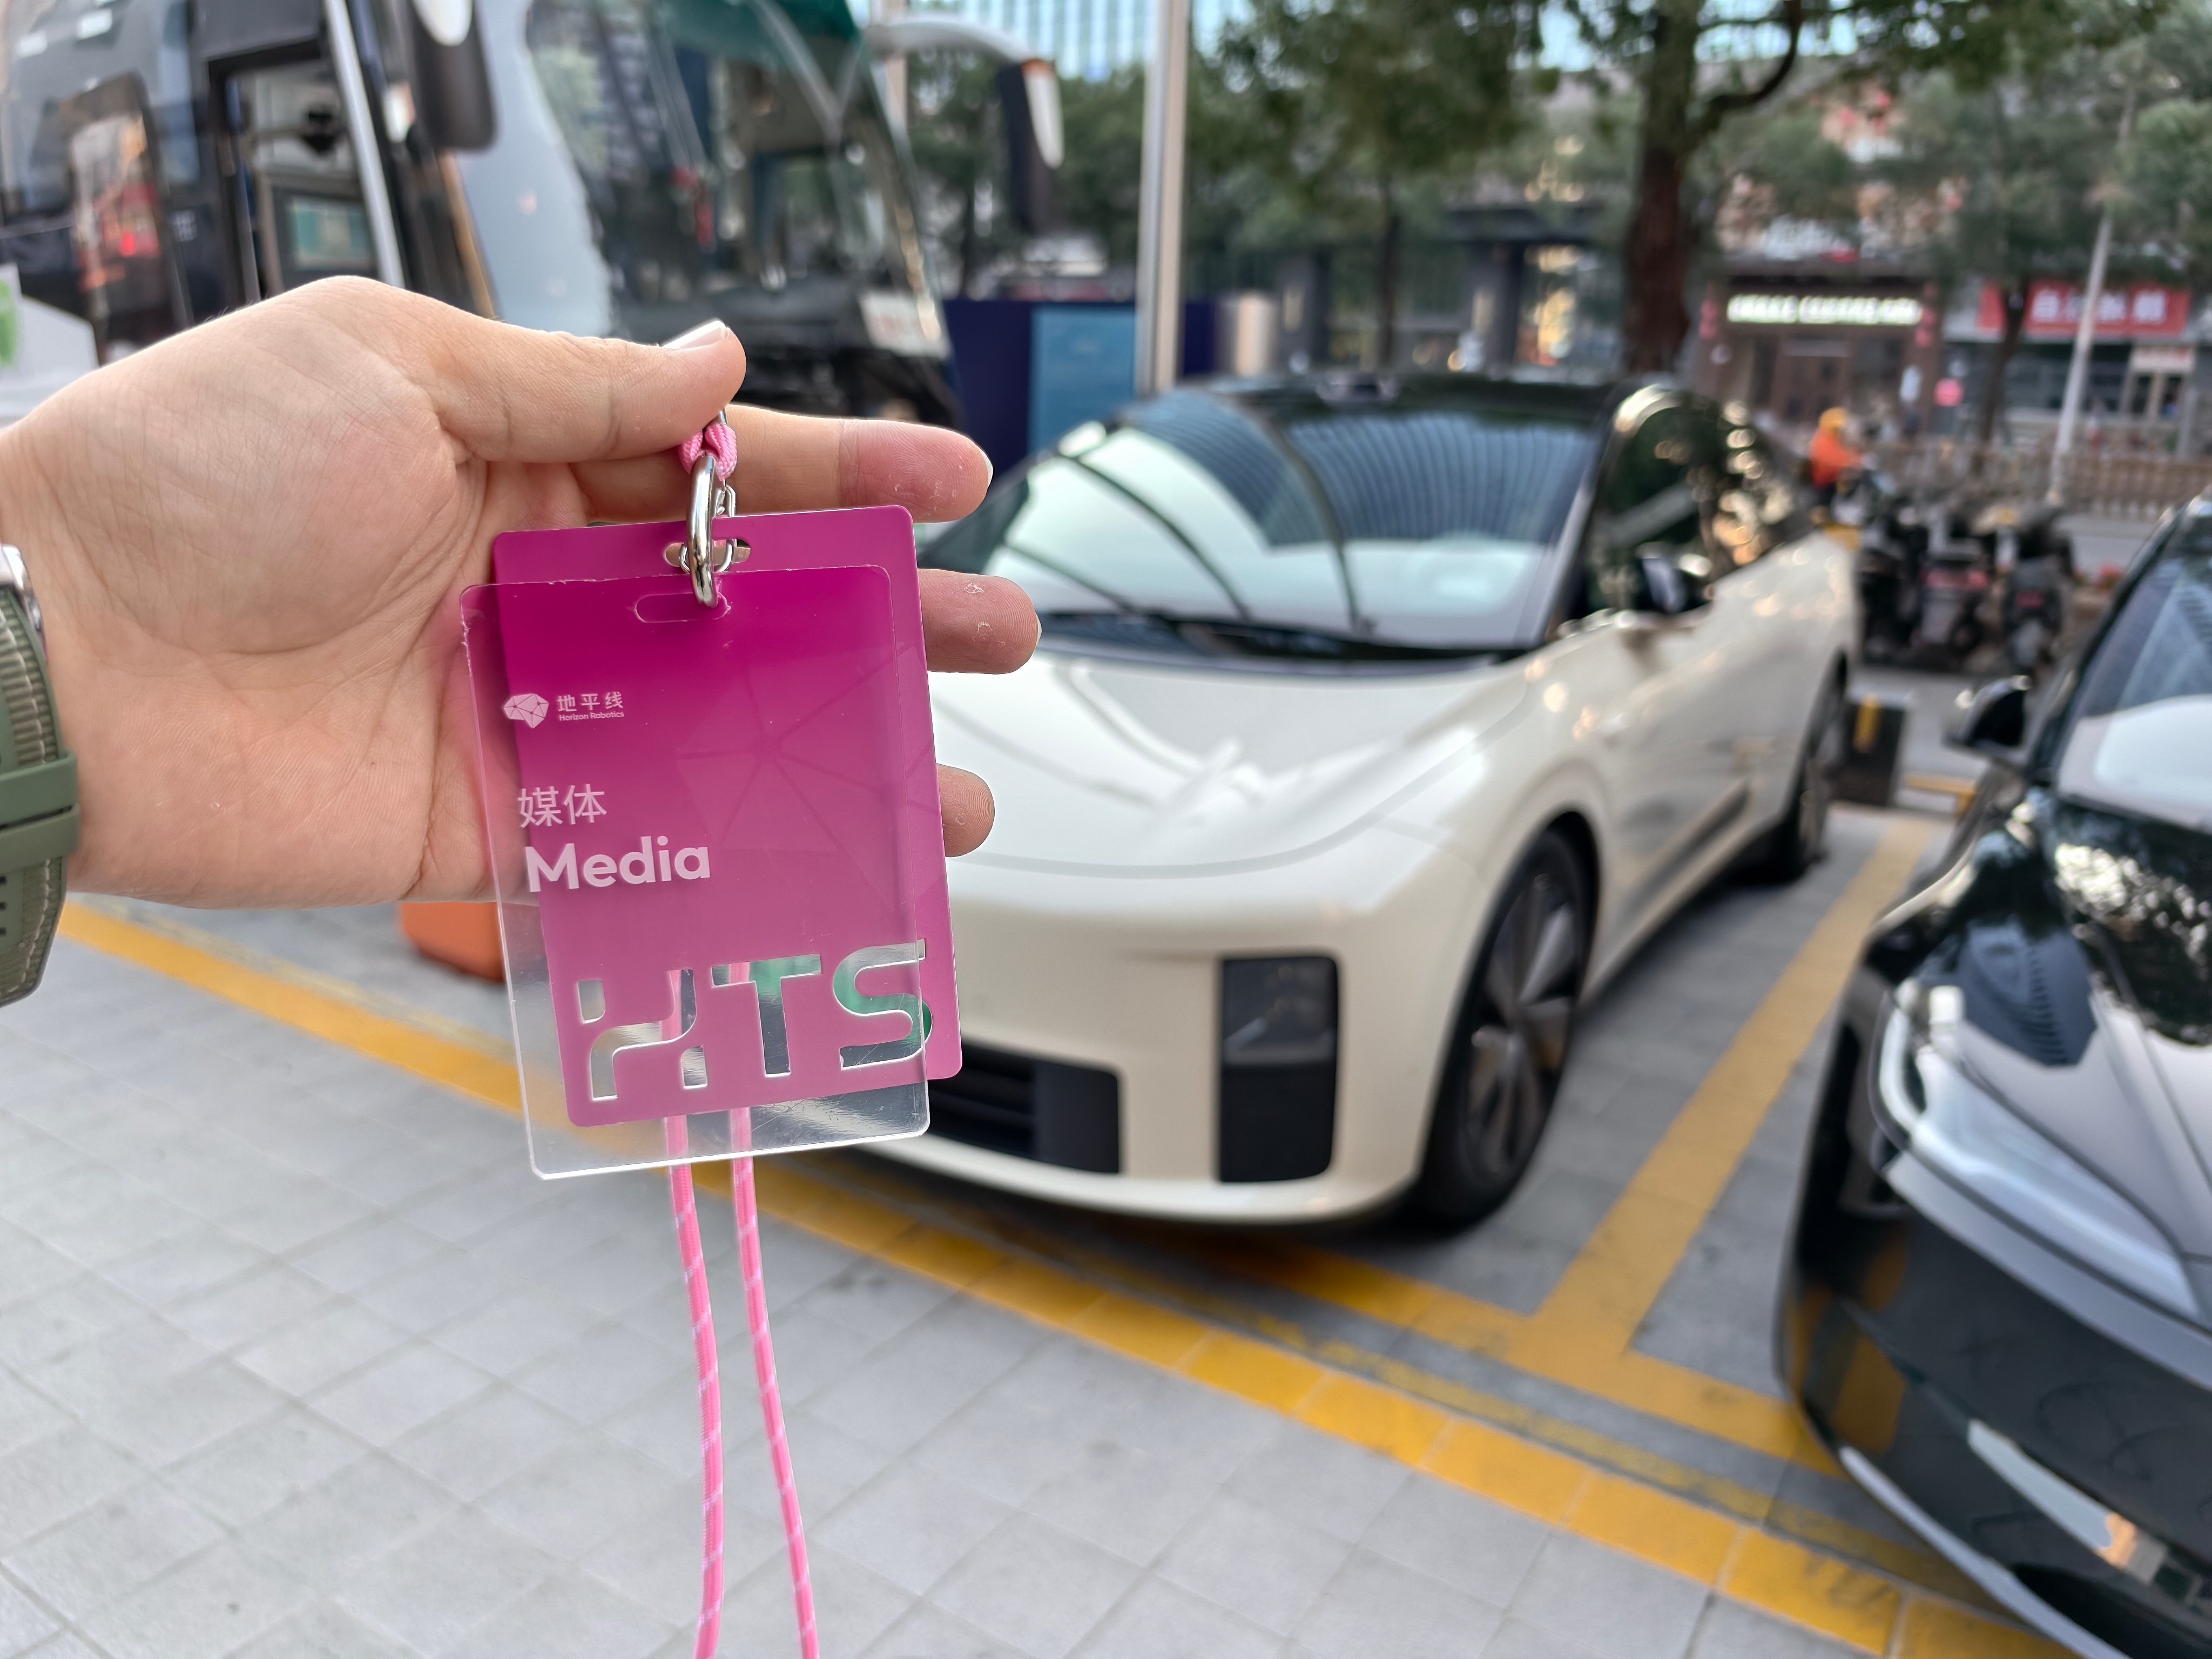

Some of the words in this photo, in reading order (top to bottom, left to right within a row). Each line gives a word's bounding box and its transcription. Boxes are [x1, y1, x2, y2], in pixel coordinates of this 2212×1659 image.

[557, 691, 624, 712] 地平线
[558, 713, 589, 721] Horizon
[590, 710, 625, 719] Robotics
[518, 784, 608, 828] 媒体
[525, 835, 711, 893] Media
